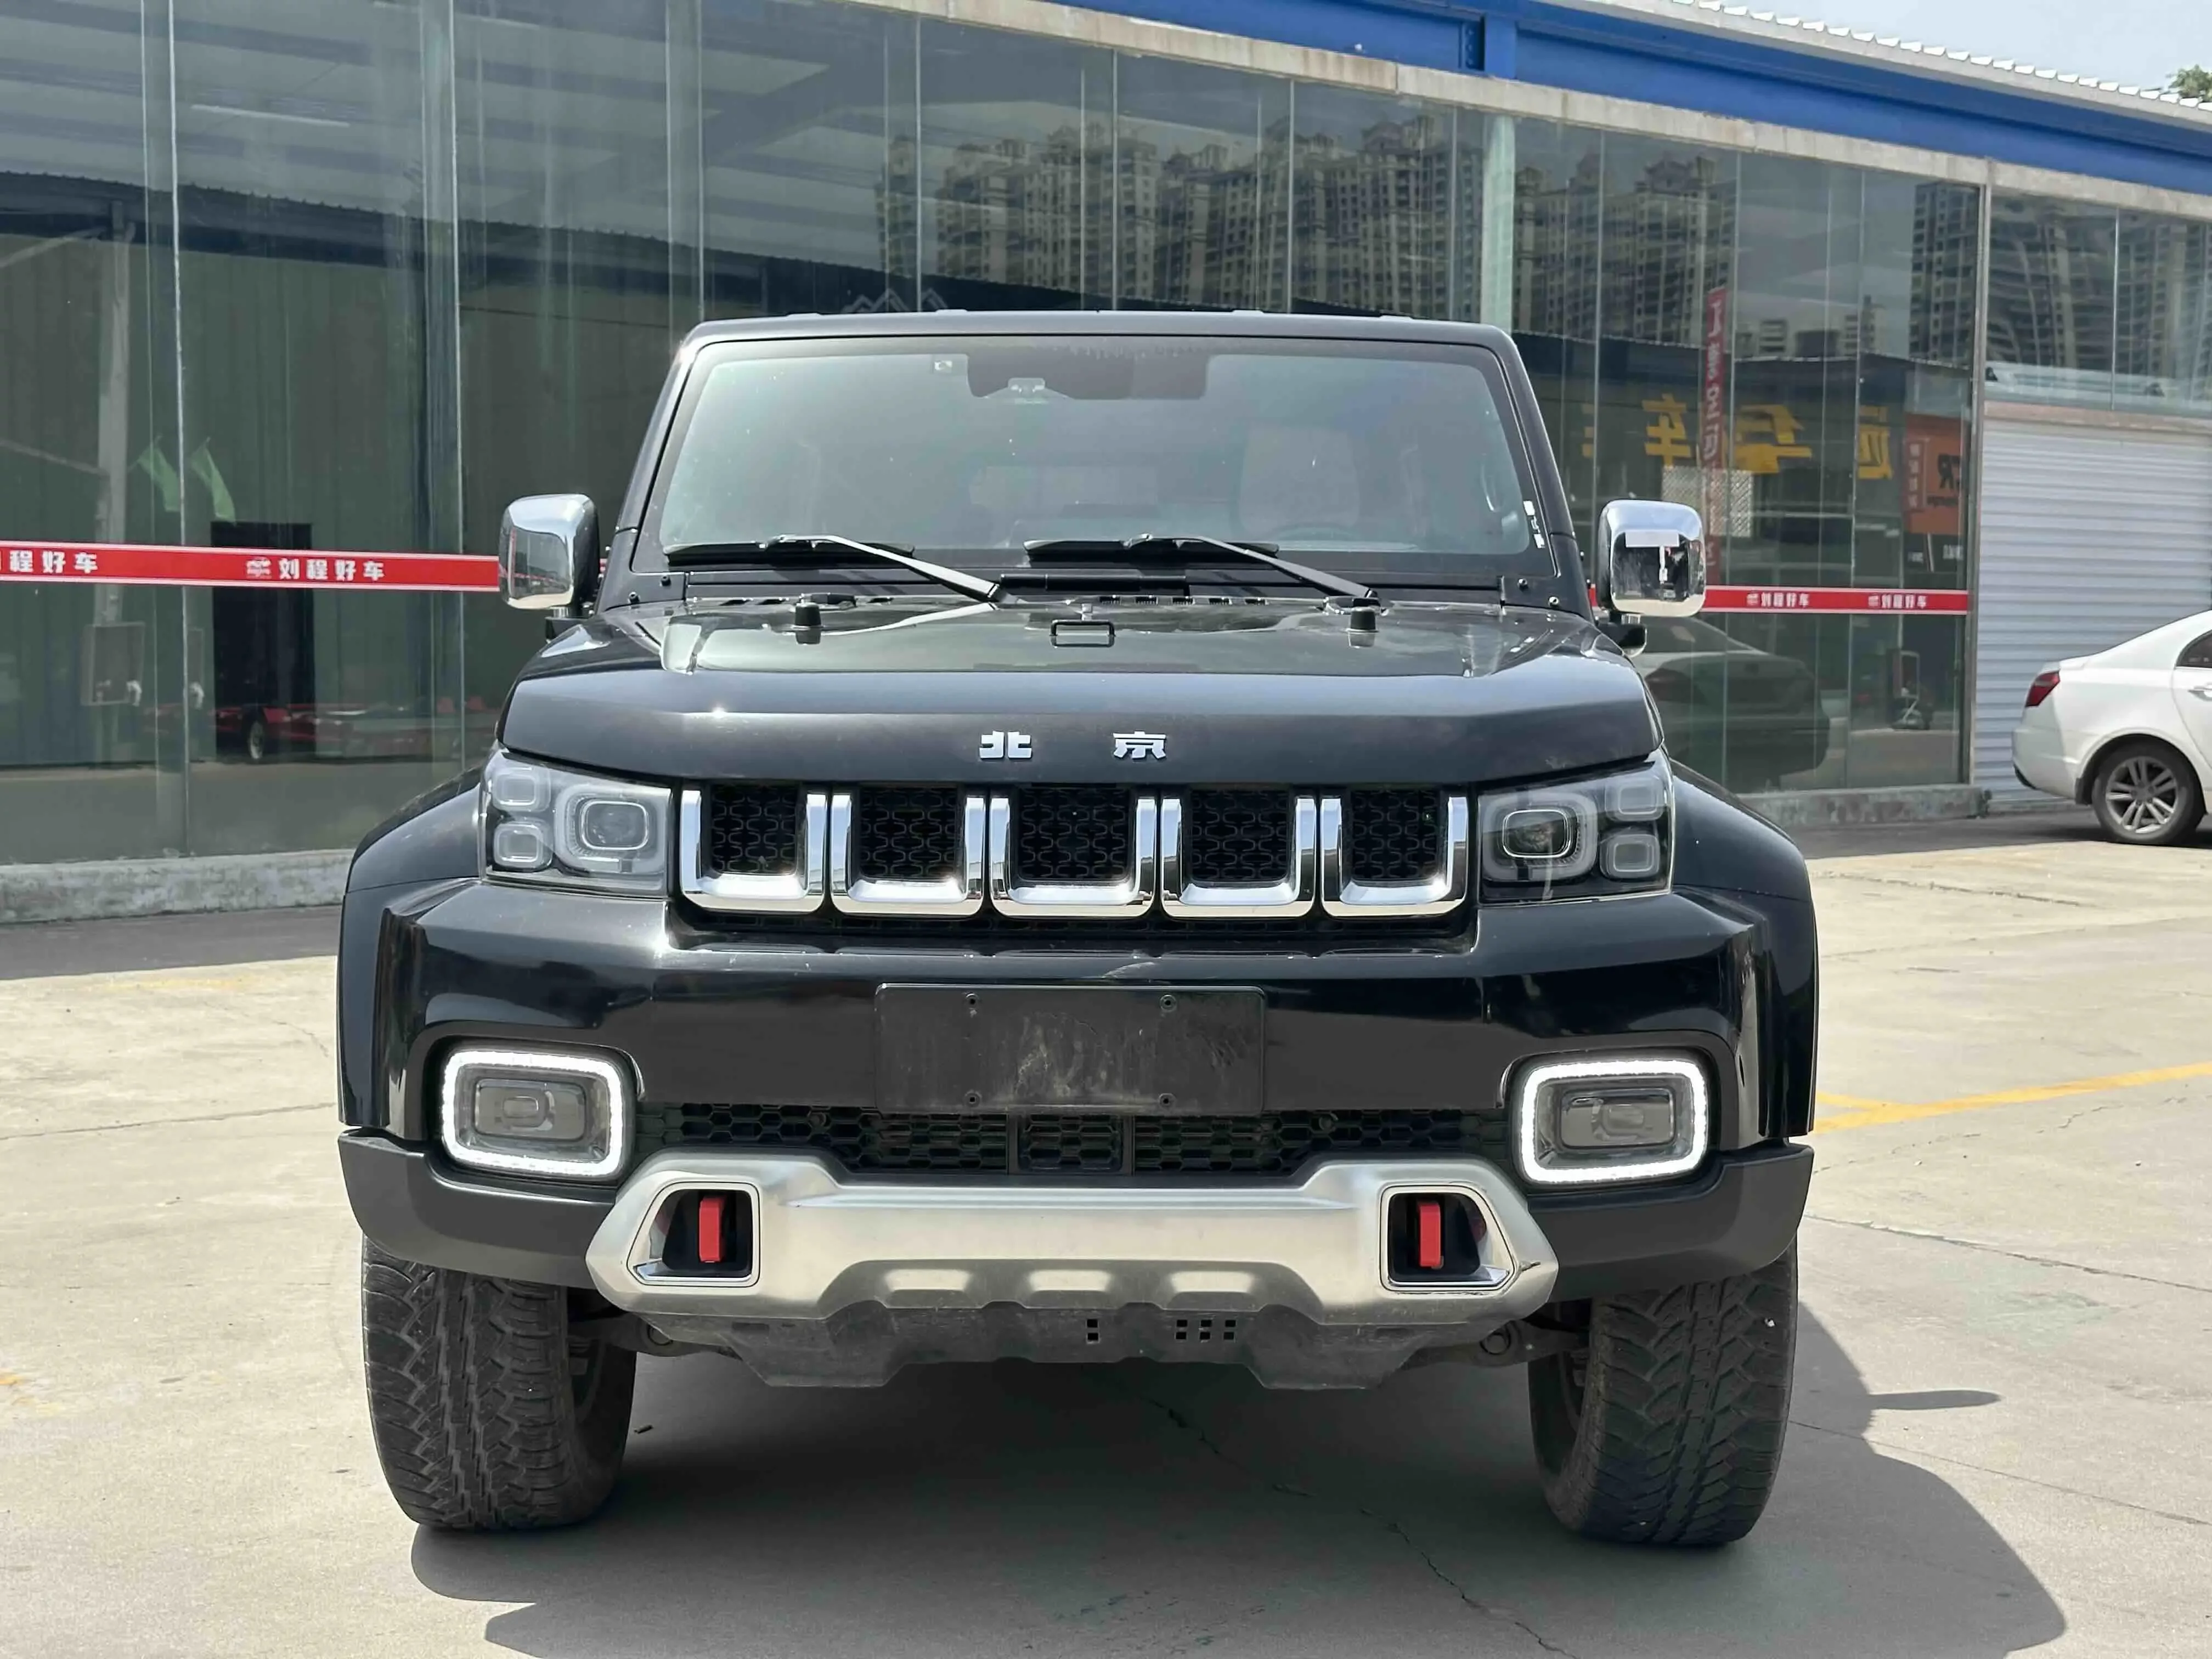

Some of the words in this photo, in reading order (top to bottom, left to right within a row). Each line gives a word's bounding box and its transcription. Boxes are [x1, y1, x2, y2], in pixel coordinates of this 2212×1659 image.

[0, 550, 98, 574] 程好车
[278, 557, 385, 582] 刘程好车
[979, 730, 1167, 760] 北京
